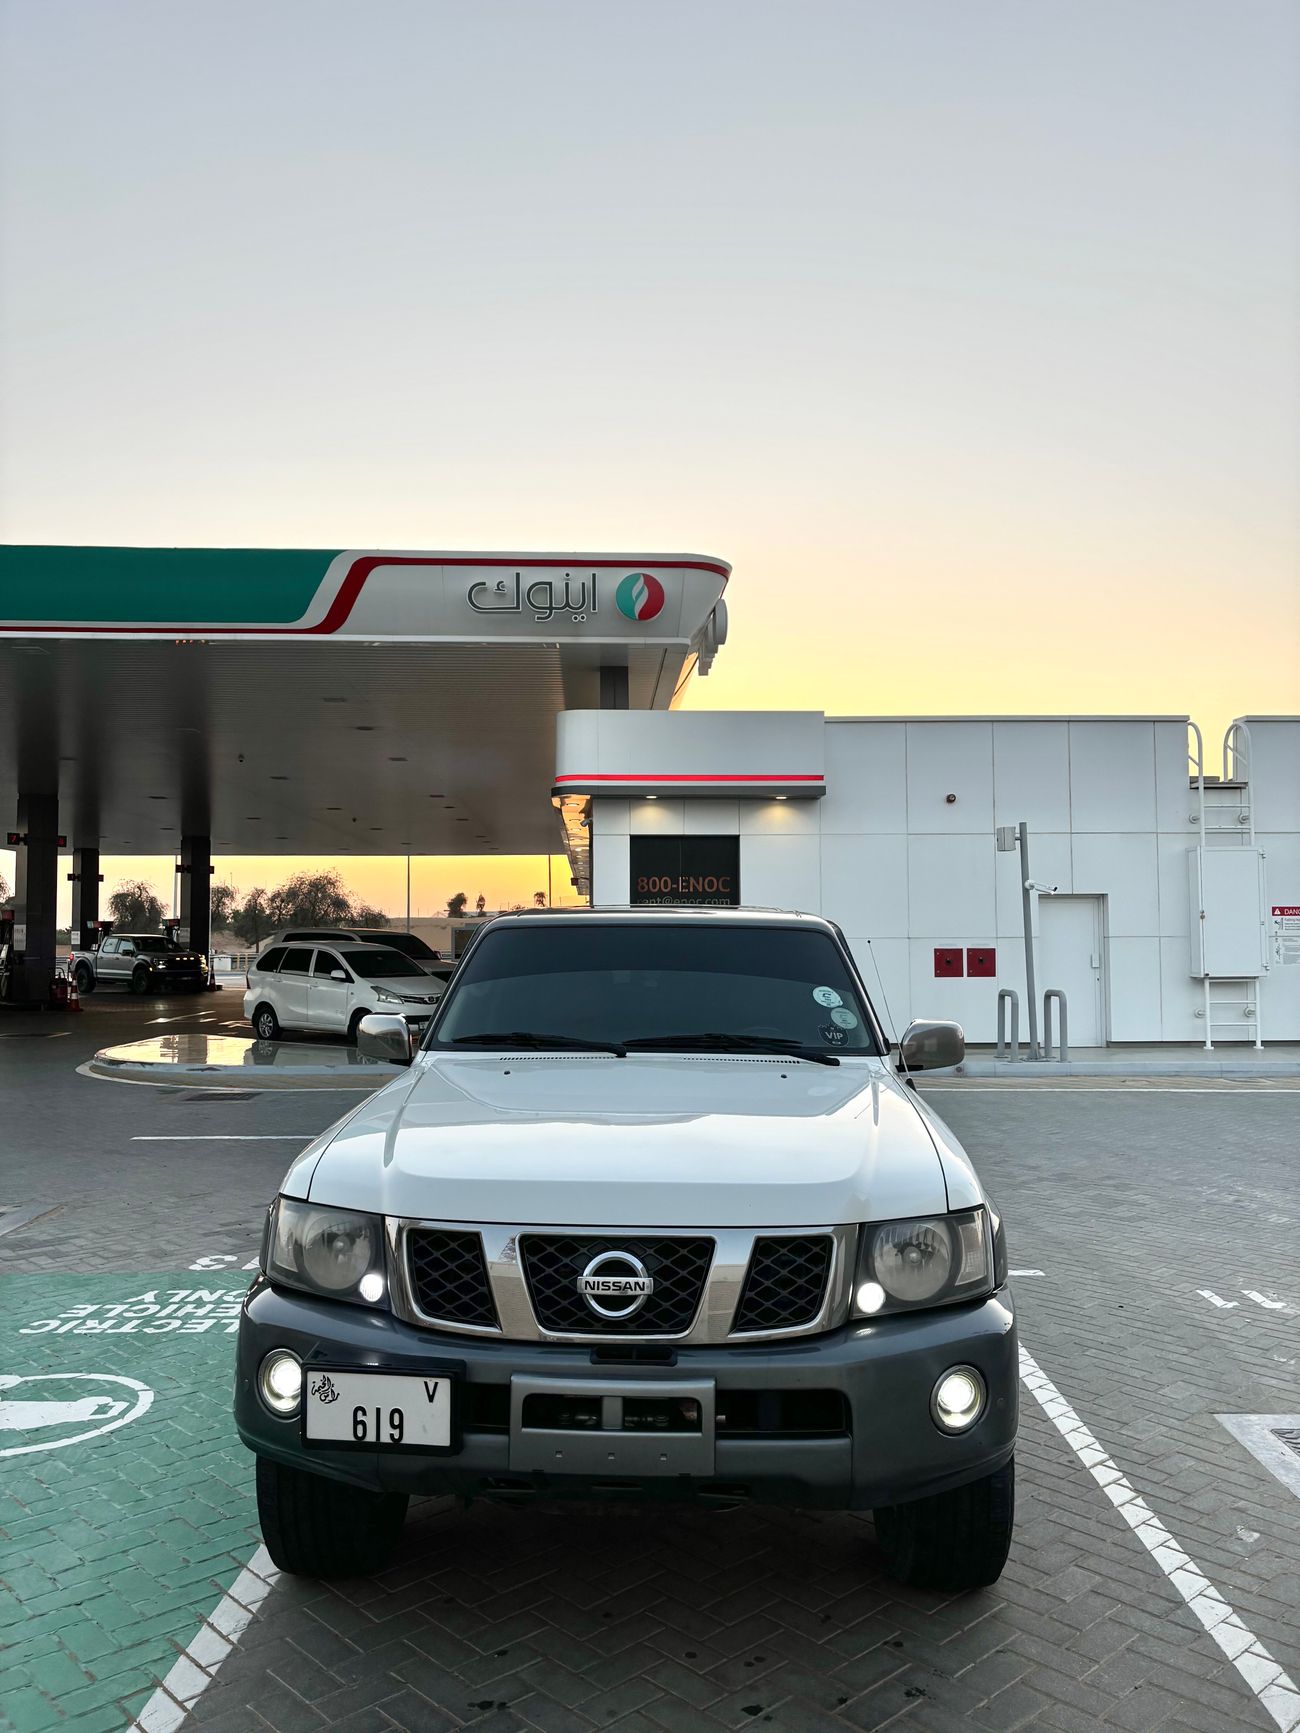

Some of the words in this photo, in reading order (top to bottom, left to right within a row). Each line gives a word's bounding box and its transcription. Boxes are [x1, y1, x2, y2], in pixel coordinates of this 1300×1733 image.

[637, 876, 730, 892] 800-ENOC
[825, 1031, 844, 1040] VIP
[584, 1280, 645, 1291] NISSAN
[57, 1304, 242, 1317] EHICLE
[19, 1318, 240, 1333] LECTRIC
[424, 1381, 438, 1403] V
[353, 1405, 404, 1443] 619
